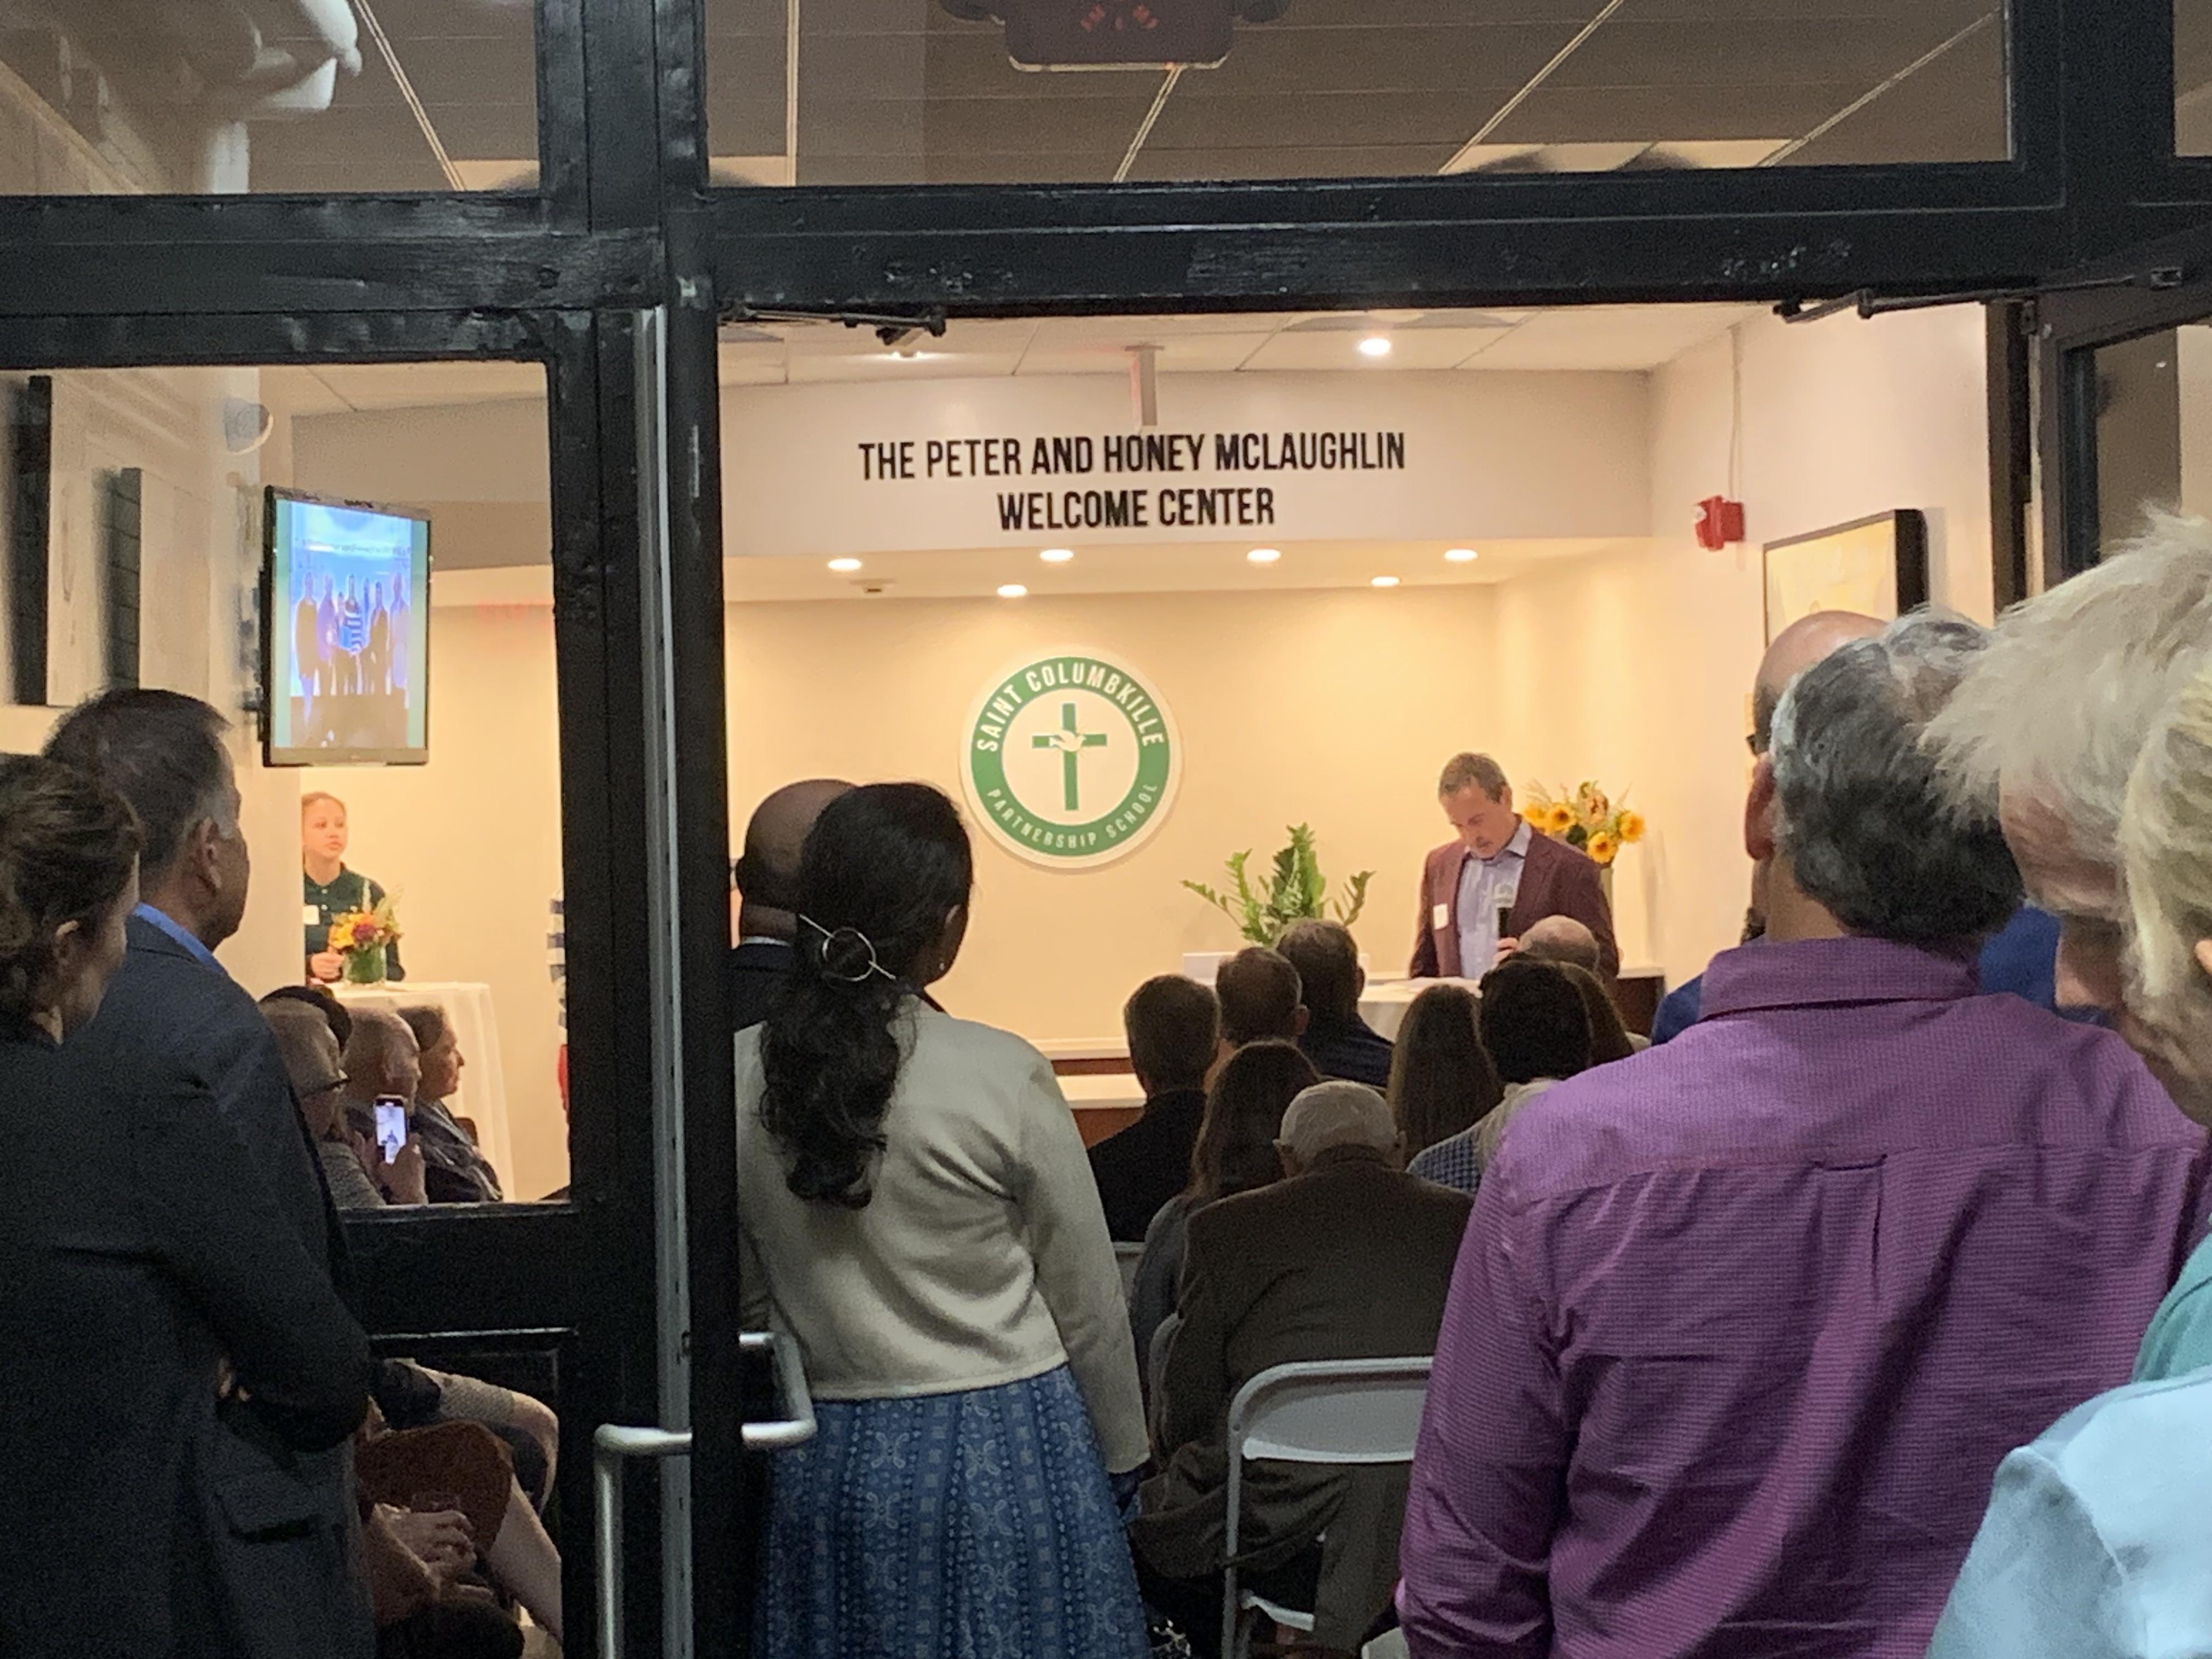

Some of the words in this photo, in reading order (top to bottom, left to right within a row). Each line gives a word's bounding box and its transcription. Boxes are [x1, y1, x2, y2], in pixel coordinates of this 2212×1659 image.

[857, 441, 915, 481] THE
[926, 438, 1022, 478] PETER
[1031, 436, 1093, 475] AND
[1103, 433, 1206, 473] HONEY
[1215, 432, 1405, 471] MCLAUGHLIN
[997, 489, 1149, 531] WELCOME
[1158, 487, 1274, 527] CENTER
[977, 685, 1022, 752] SAINT
[1025, 662, 1165, 747] COLUMBKILLE
[986, 788, 1097, 849] PARTNERSHIP
[1105, 783, 1158, 839] SCHOOL
